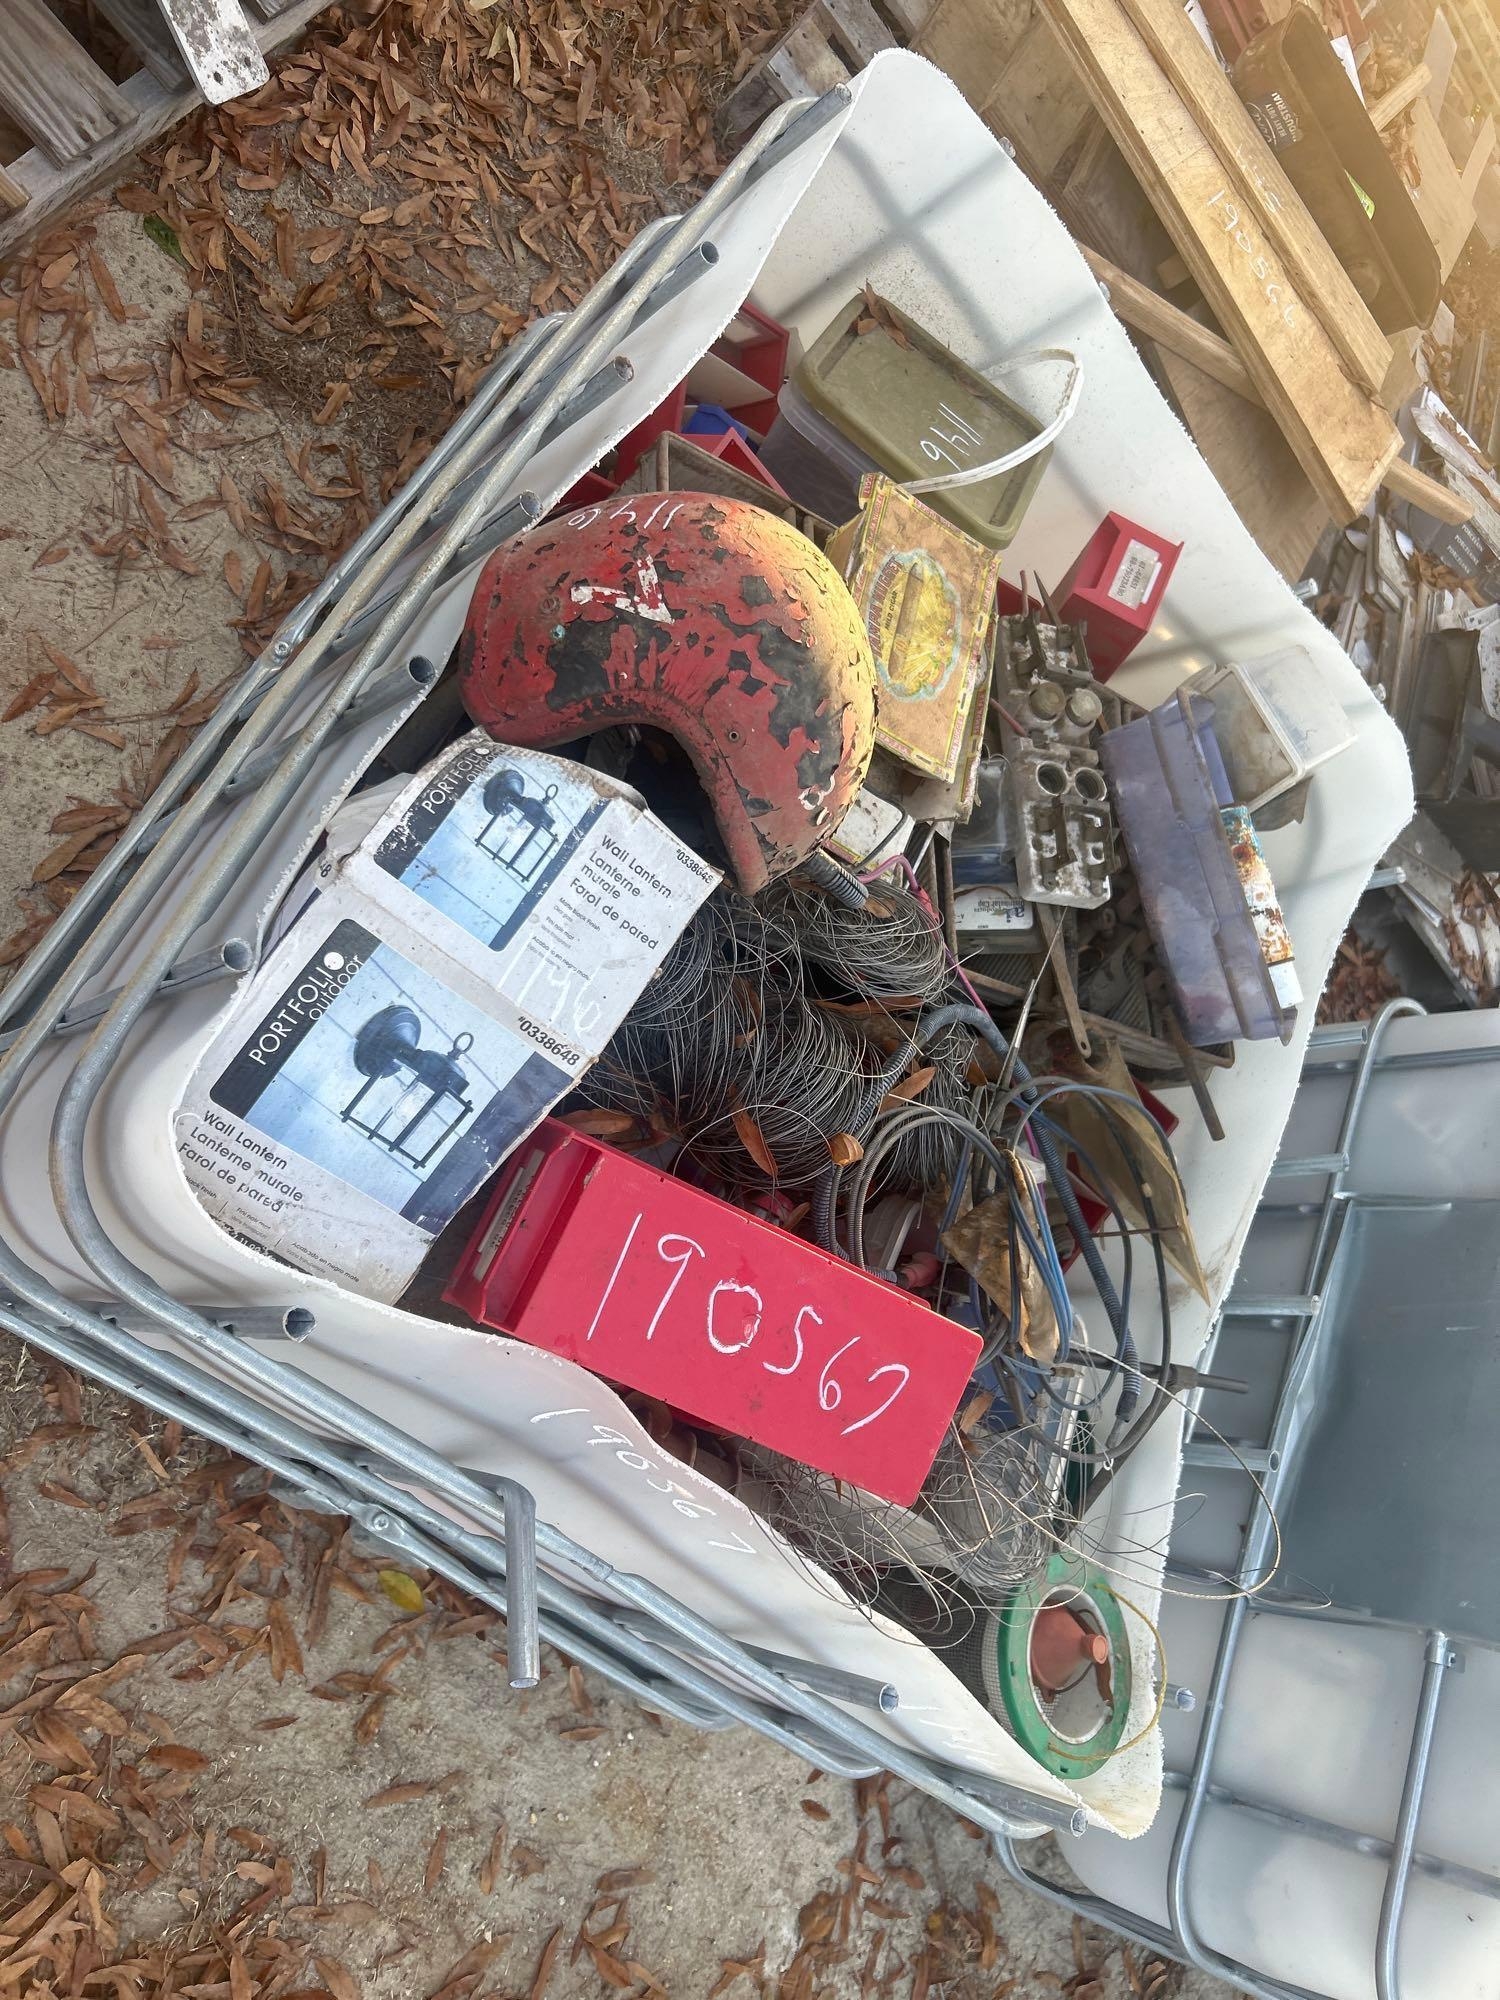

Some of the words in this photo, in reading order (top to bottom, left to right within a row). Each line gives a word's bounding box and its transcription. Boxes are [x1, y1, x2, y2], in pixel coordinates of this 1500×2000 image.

[1265, 103, 1279, 119] DUTY
[1271, 92, 1297, 142] DUSTRIAL
[1207, 189, 1296, 328] 190566
[919, 402, 984, 472] 1146
[567, 498, 685, 530] 1146
[871, 555, 903, 602] NUGGET
[889, 590, 899, 614] CIGAR
[868, 602, 883, 661] TAMPA
[581, 864, 621, 900] murale
[589, 850, 642, 898] Lanterne
[601, 835, 630, 862] Wall
[628, 858, 673, 899] Lantern
[569, 878, 601, 907] Farol
[602, 904, 620, 922] de
[619, 918, 659, 951] pared
[309, 954, 366, 1021] outdoor
[518, 1015, 581, 1066] #0338648
[190, 1126, 251, 1171] Lanterne
[257, 1169, 303, 1202] murale
[204, 1110, 235, 1137] Wall
[235, 1131, 288, 1170] Lantern
[178, 1142, 216, 1172] Farol
[217, 1166, 236, 1185] de
[237, 1182, 284, 1213] pared
[586, 1213, 910, 1436] 190567
[529, 1408, 758, 1555] 190567
